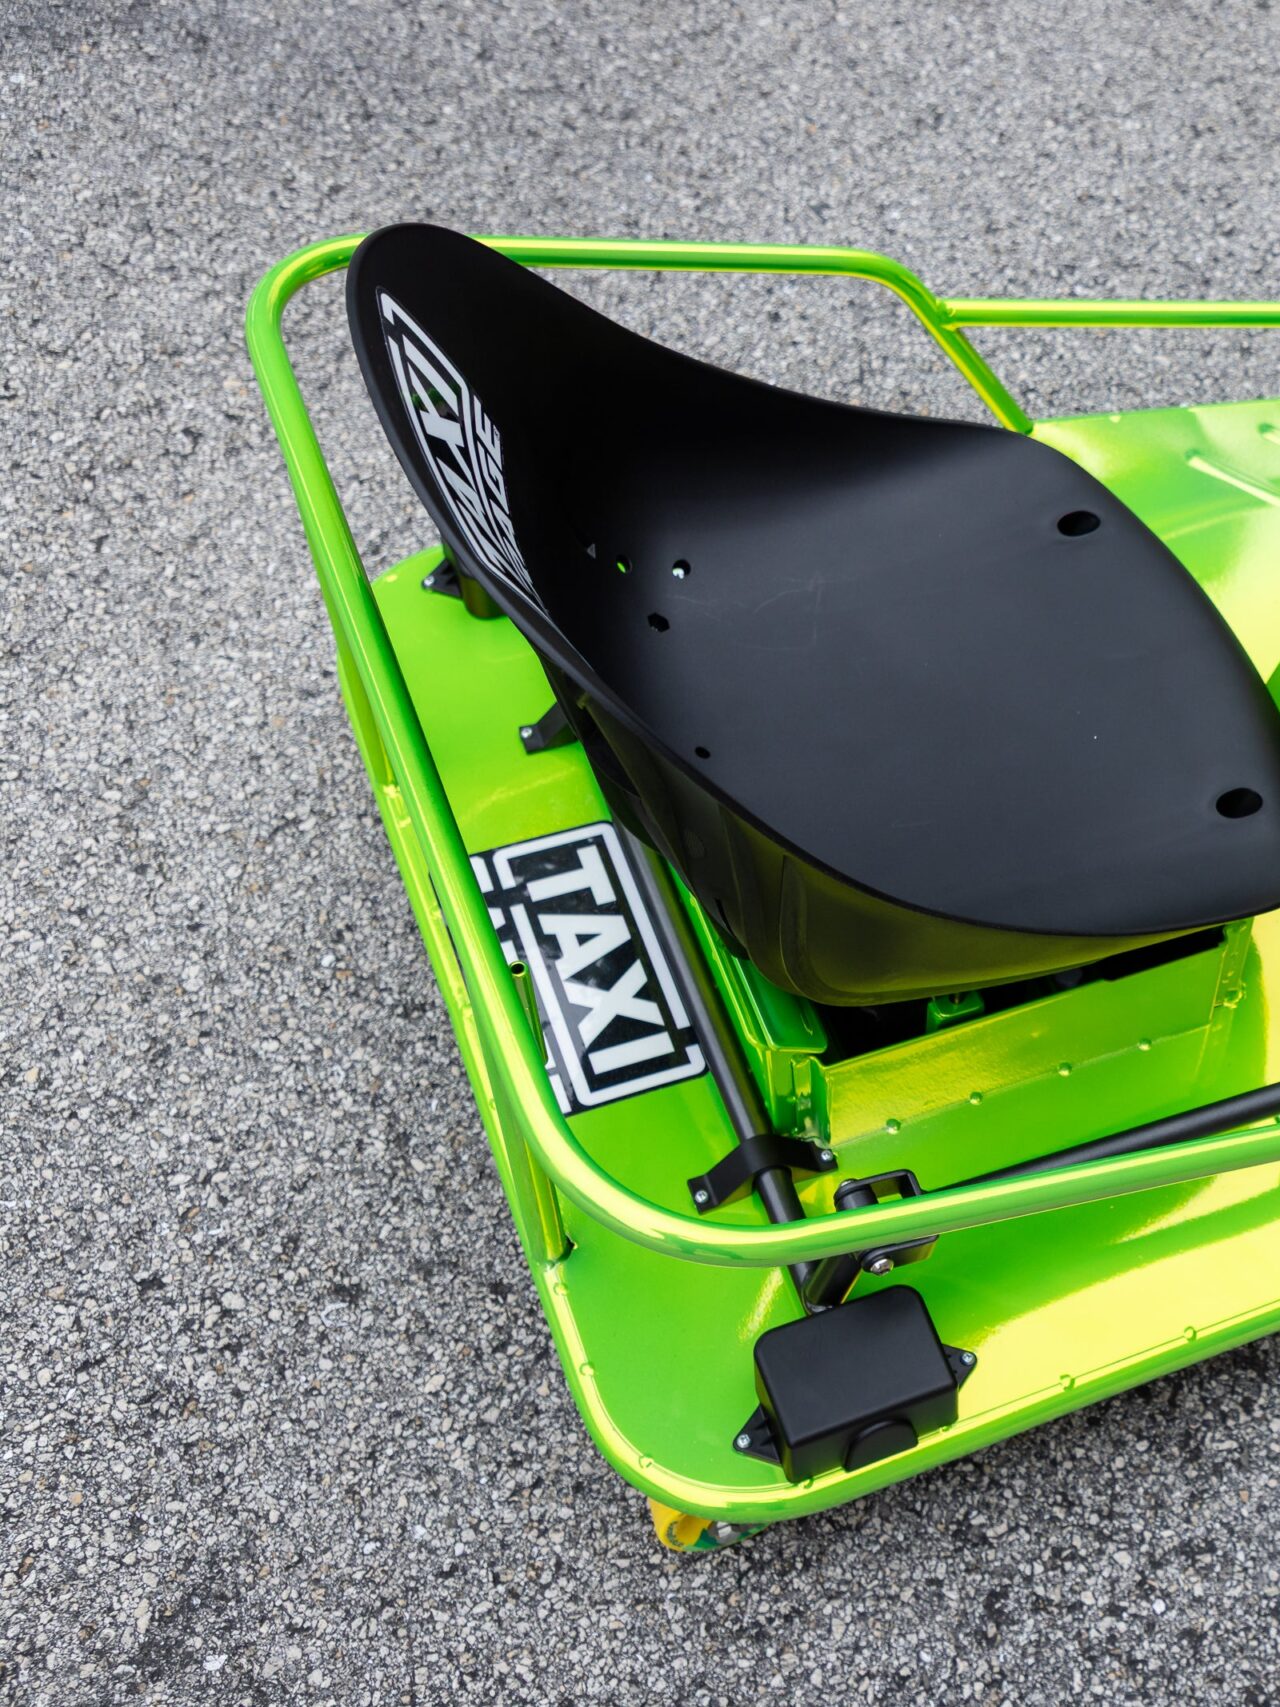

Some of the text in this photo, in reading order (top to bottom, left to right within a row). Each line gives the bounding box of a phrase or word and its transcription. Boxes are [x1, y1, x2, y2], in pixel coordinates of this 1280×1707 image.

[402, 334, 532, 594] TAXI
[474, 395, 551, 618] RAGE
[526, 845, 675, 1074] TAXI
